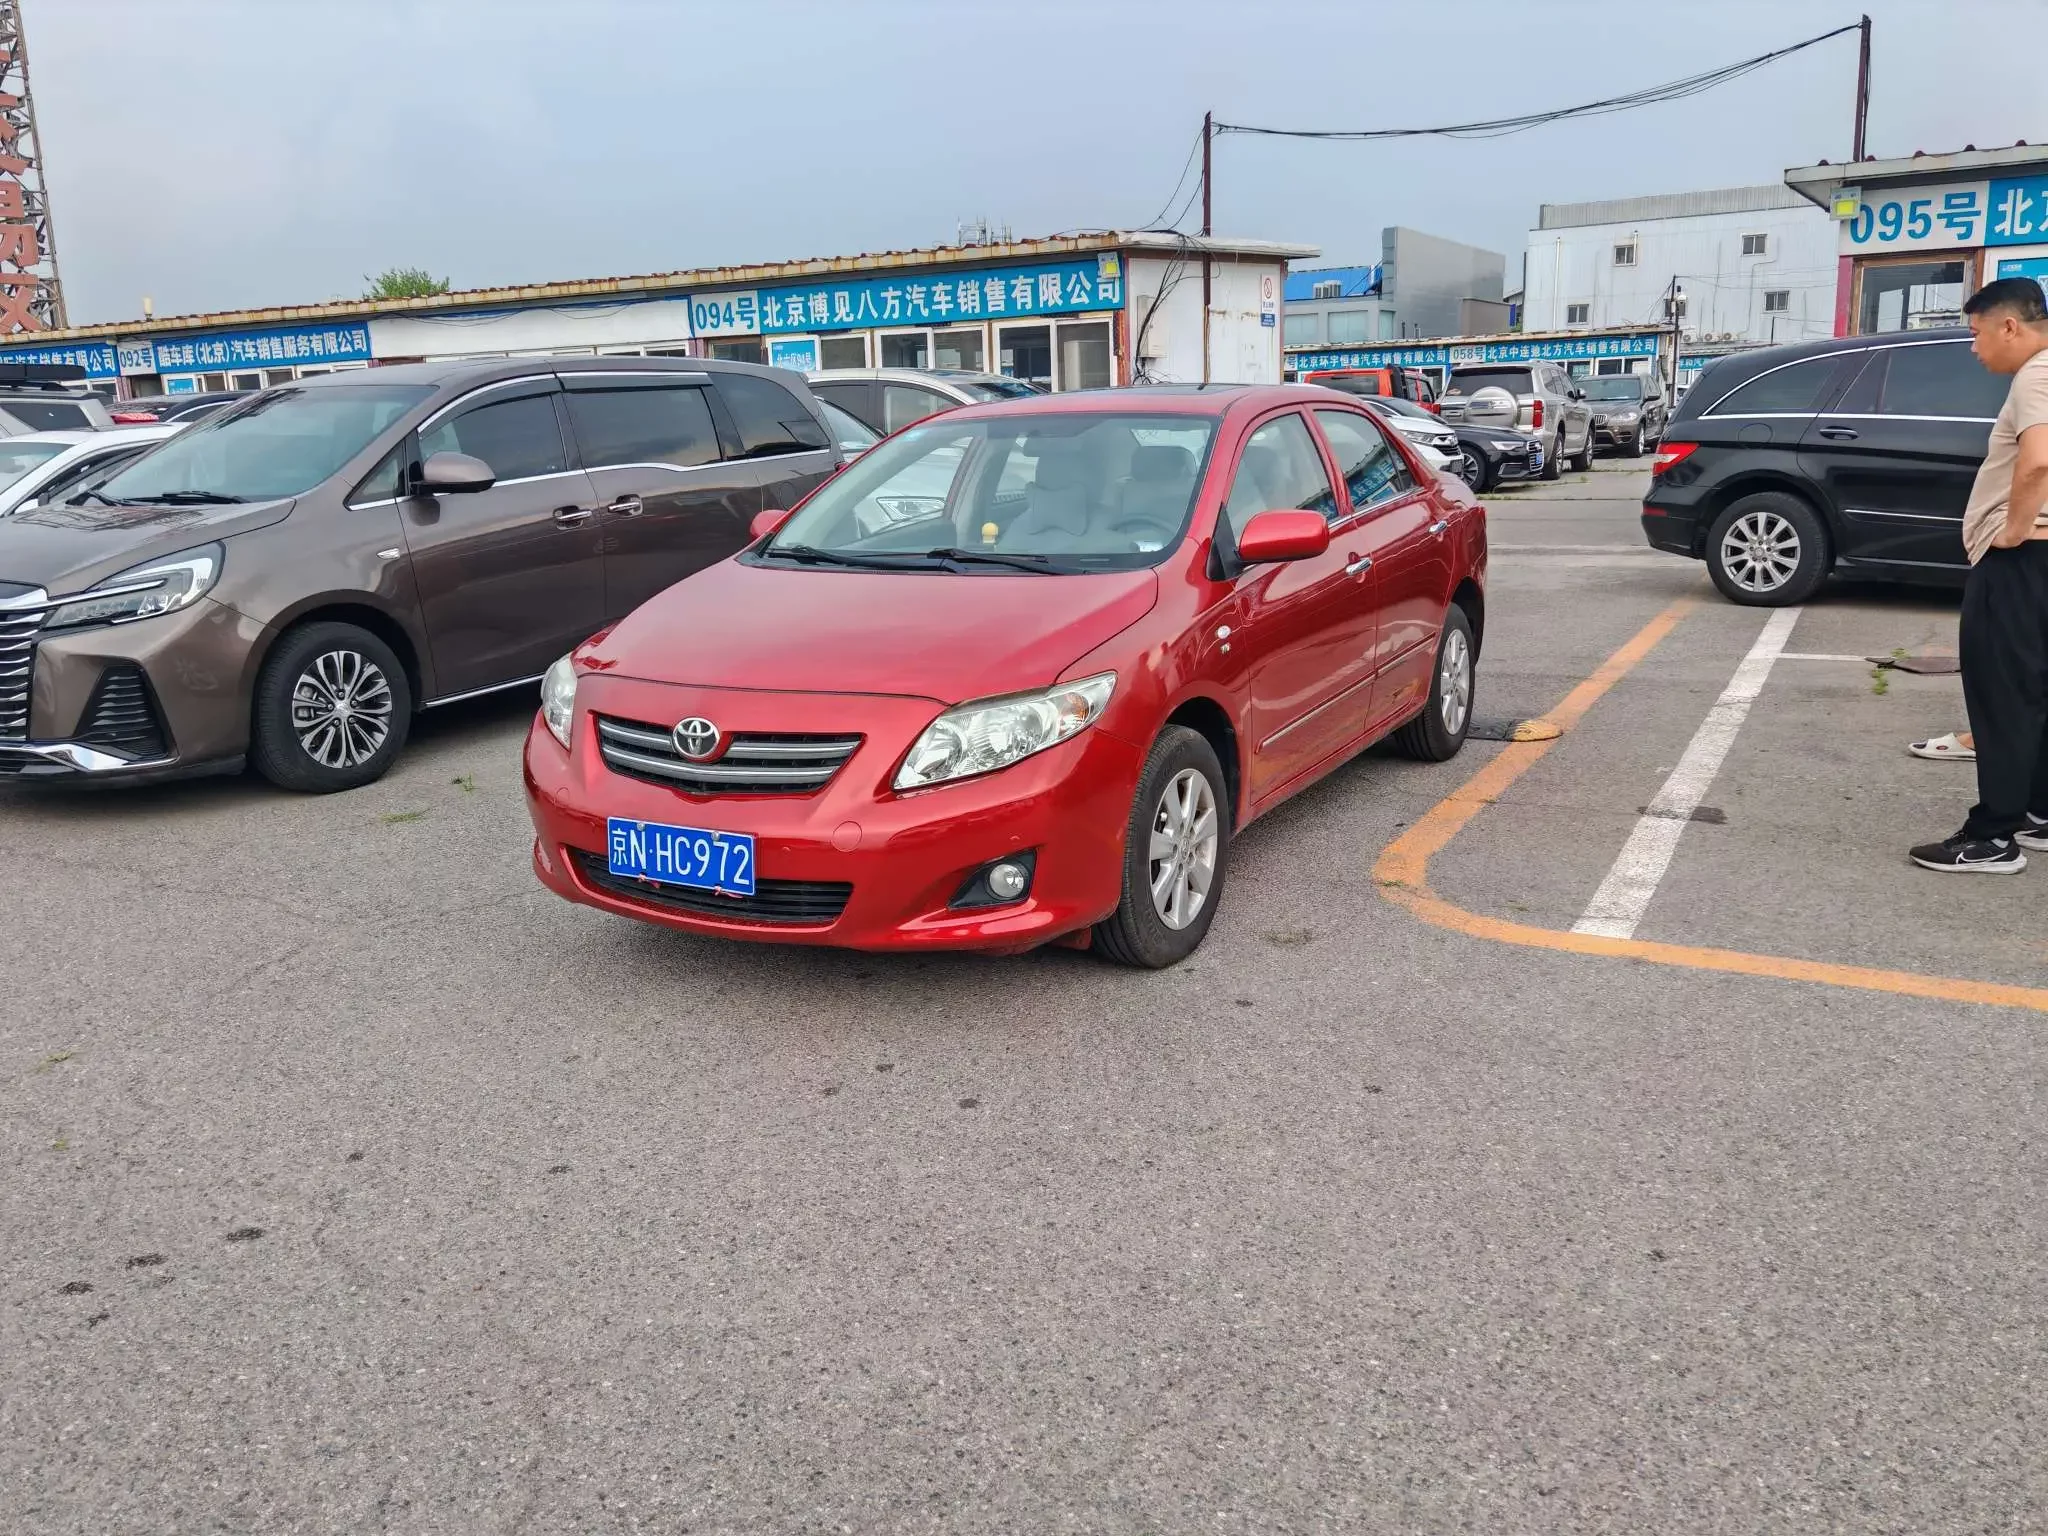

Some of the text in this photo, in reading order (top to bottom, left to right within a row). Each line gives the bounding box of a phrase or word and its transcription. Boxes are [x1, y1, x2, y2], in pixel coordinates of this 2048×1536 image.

[1850, 191, 1982, 243] 095号
[1994, 188, 2048, 237] 北
[695, 298, 757, 331] 094号
[762, 270, 1120, 328] 北京博见八方汽车销售有限公司
[119, 349, 152, 369] 092号
[156, 330, 367, 368] 酷车库(北京)汽车销售服务有限公司
[1453, 345, 1485, 361] 058号
[611, 828, 750, 885] 京N·HC972
